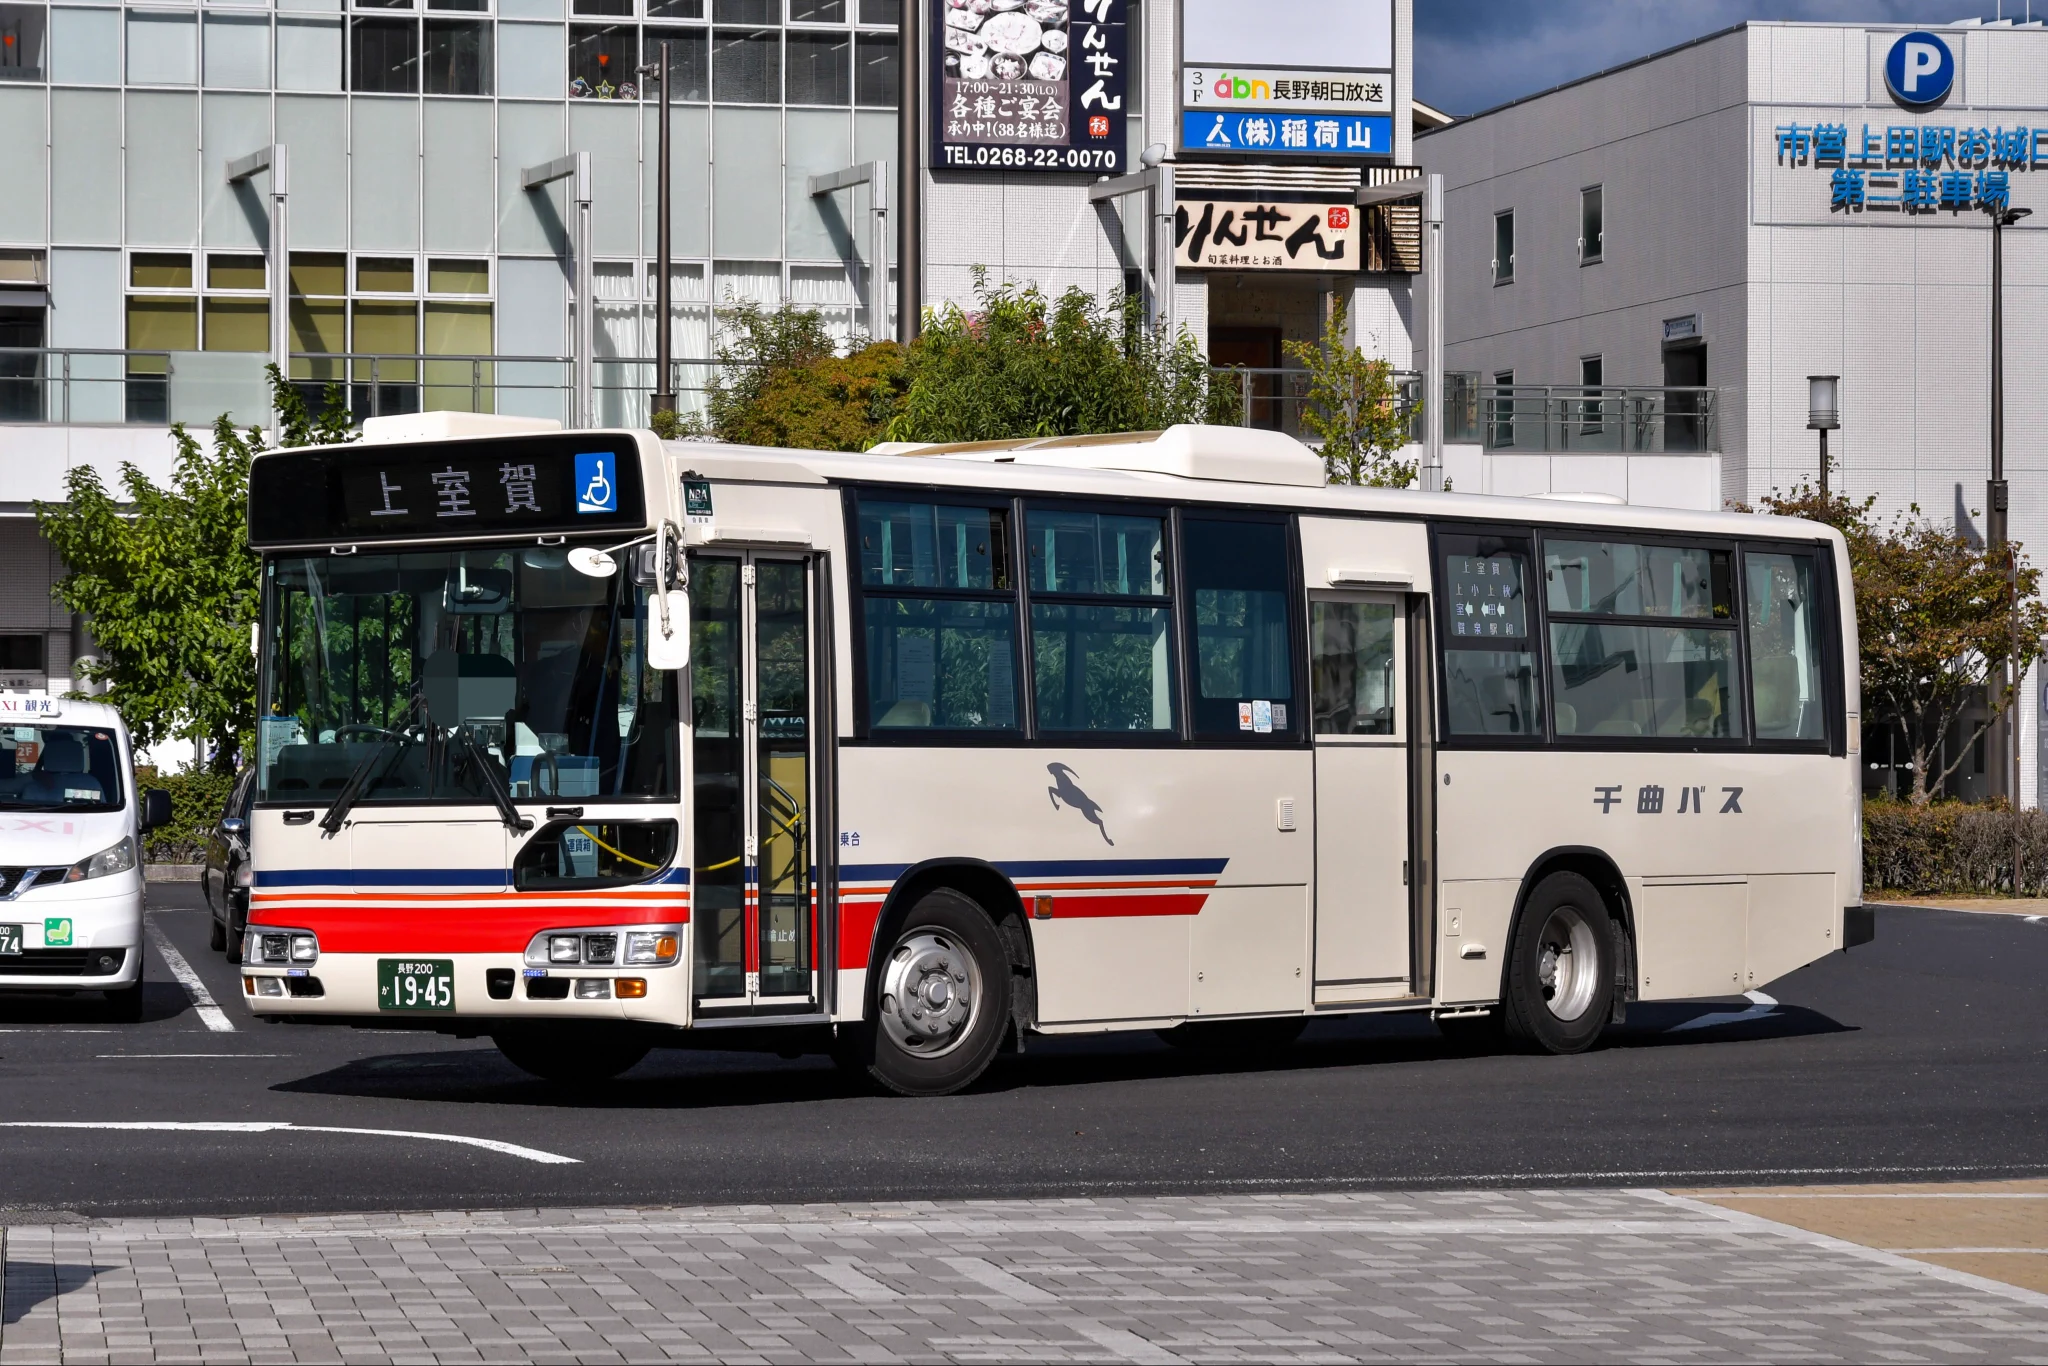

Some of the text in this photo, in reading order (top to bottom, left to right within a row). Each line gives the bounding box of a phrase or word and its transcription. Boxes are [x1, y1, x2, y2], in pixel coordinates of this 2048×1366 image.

[1904, 42, 1942, 92] P
[1214, 73, 1384, 103] abn 長野朝日放送
[949, 95, 1064, 121] 各種ご宴会
[1237, 118, 1372, 149] (株)稲荷山
[944, 146, 1116, 168] TEL.0268-22-0070
[1831, 168, 2011, 208] 第二駐車場
[1175, 203, 1345, 263] りんせん
[1207, 253, 1283, 267] 旬菜料理とお酒
[370, 463, 542, 517] 上室賀
[1462, 560, 1501, 576] 上室賀
[0, 699, 52, 713] XI 観光
[1593, 784, 1744, 814] 千曲バス
[0, 819, 75, 835] XI
[840, 831, 861, 847] 乗合
[394, 975, 451, 1007] 19-45
